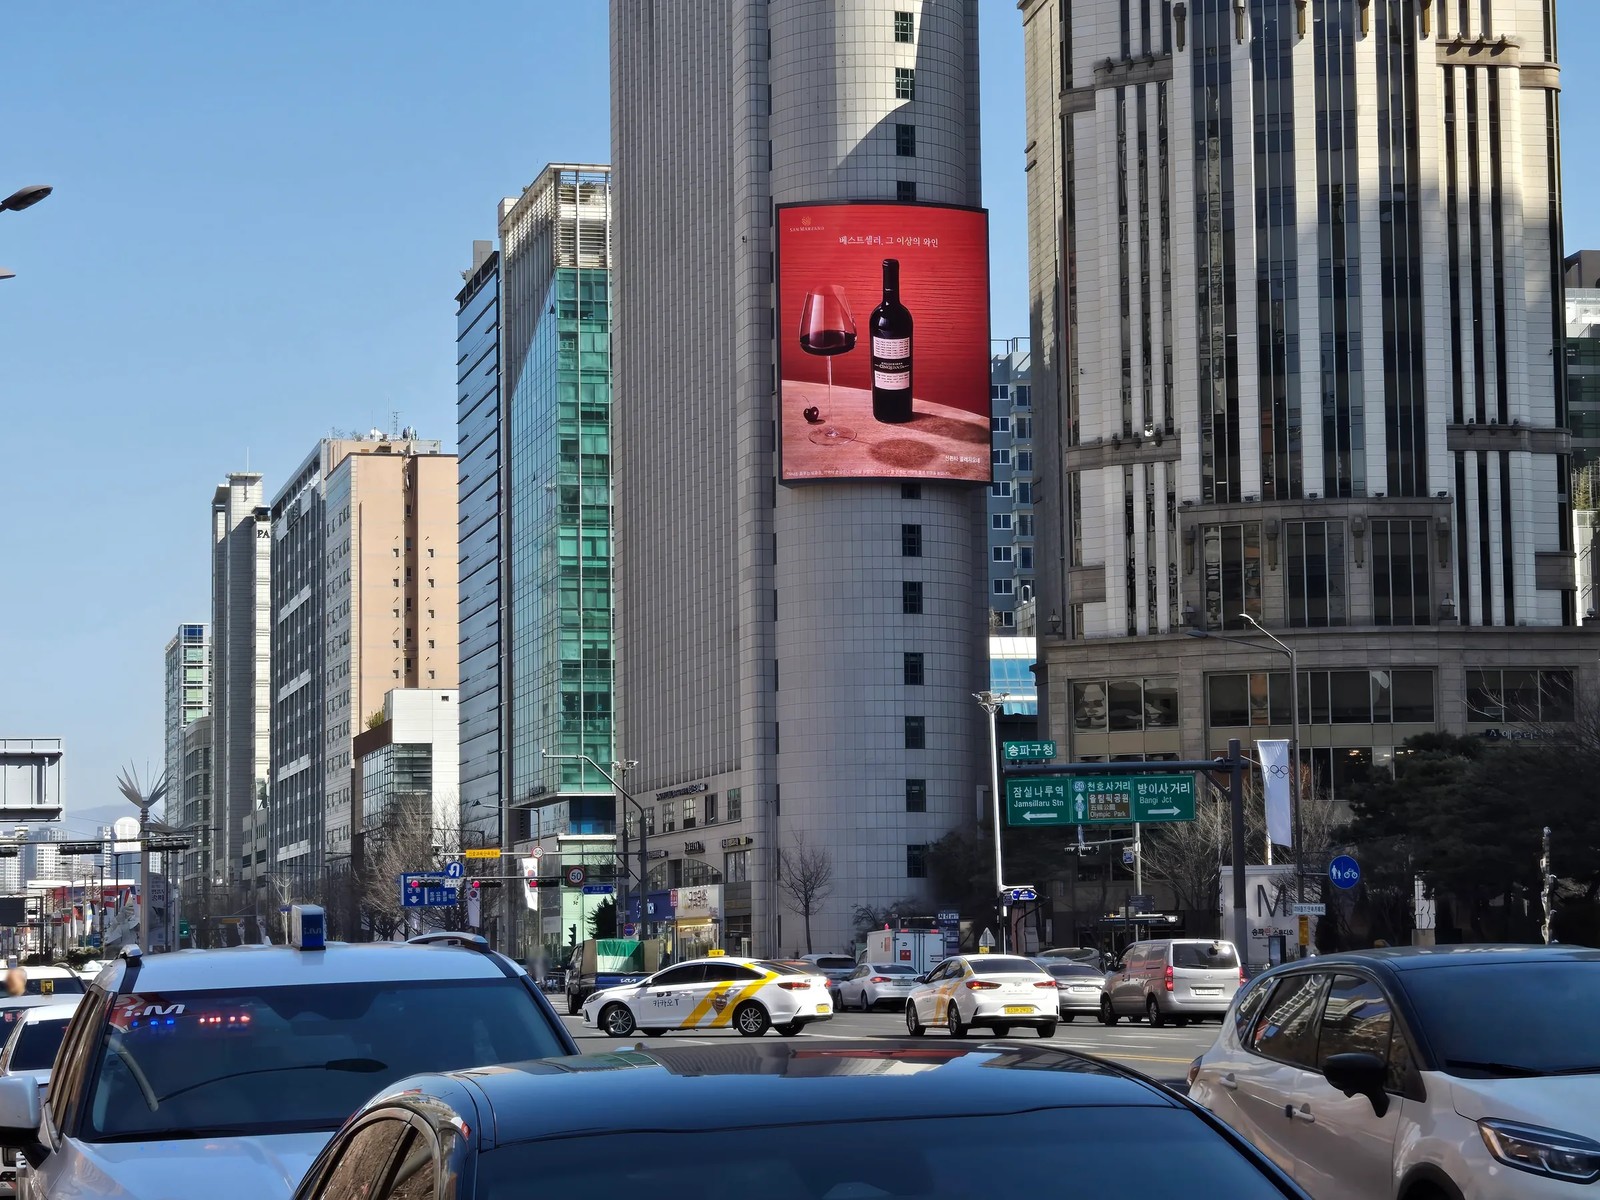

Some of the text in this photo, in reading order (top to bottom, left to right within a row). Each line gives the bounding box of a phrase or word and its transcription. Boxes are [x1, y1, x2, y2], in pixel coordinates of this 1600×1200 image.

[885, 236, 894, 245] 그
[897, 236, 921, 247] 이상의
[923, 237, 939, 248] 와인
[257, 529, 270, 538] PA
[1008, 743, 1054, 757] 송파구청
[1013, 785, 1064, 798] 잠실나루역
[1087, 781, 1131, 791] 천호사거리
[1137, 782, 1190, 795] 방이사거리
[1013, 800, 1051, 808] Jamsillaru
[1052, 799, 1064, 807] Stn
[1089, 793, 1129, 804] 올림픽공원
[1139, 796, 1173, 806] Bangi Jct
[571, 872, 582, 881] 50
[1257, 884, 1287, 918] M
